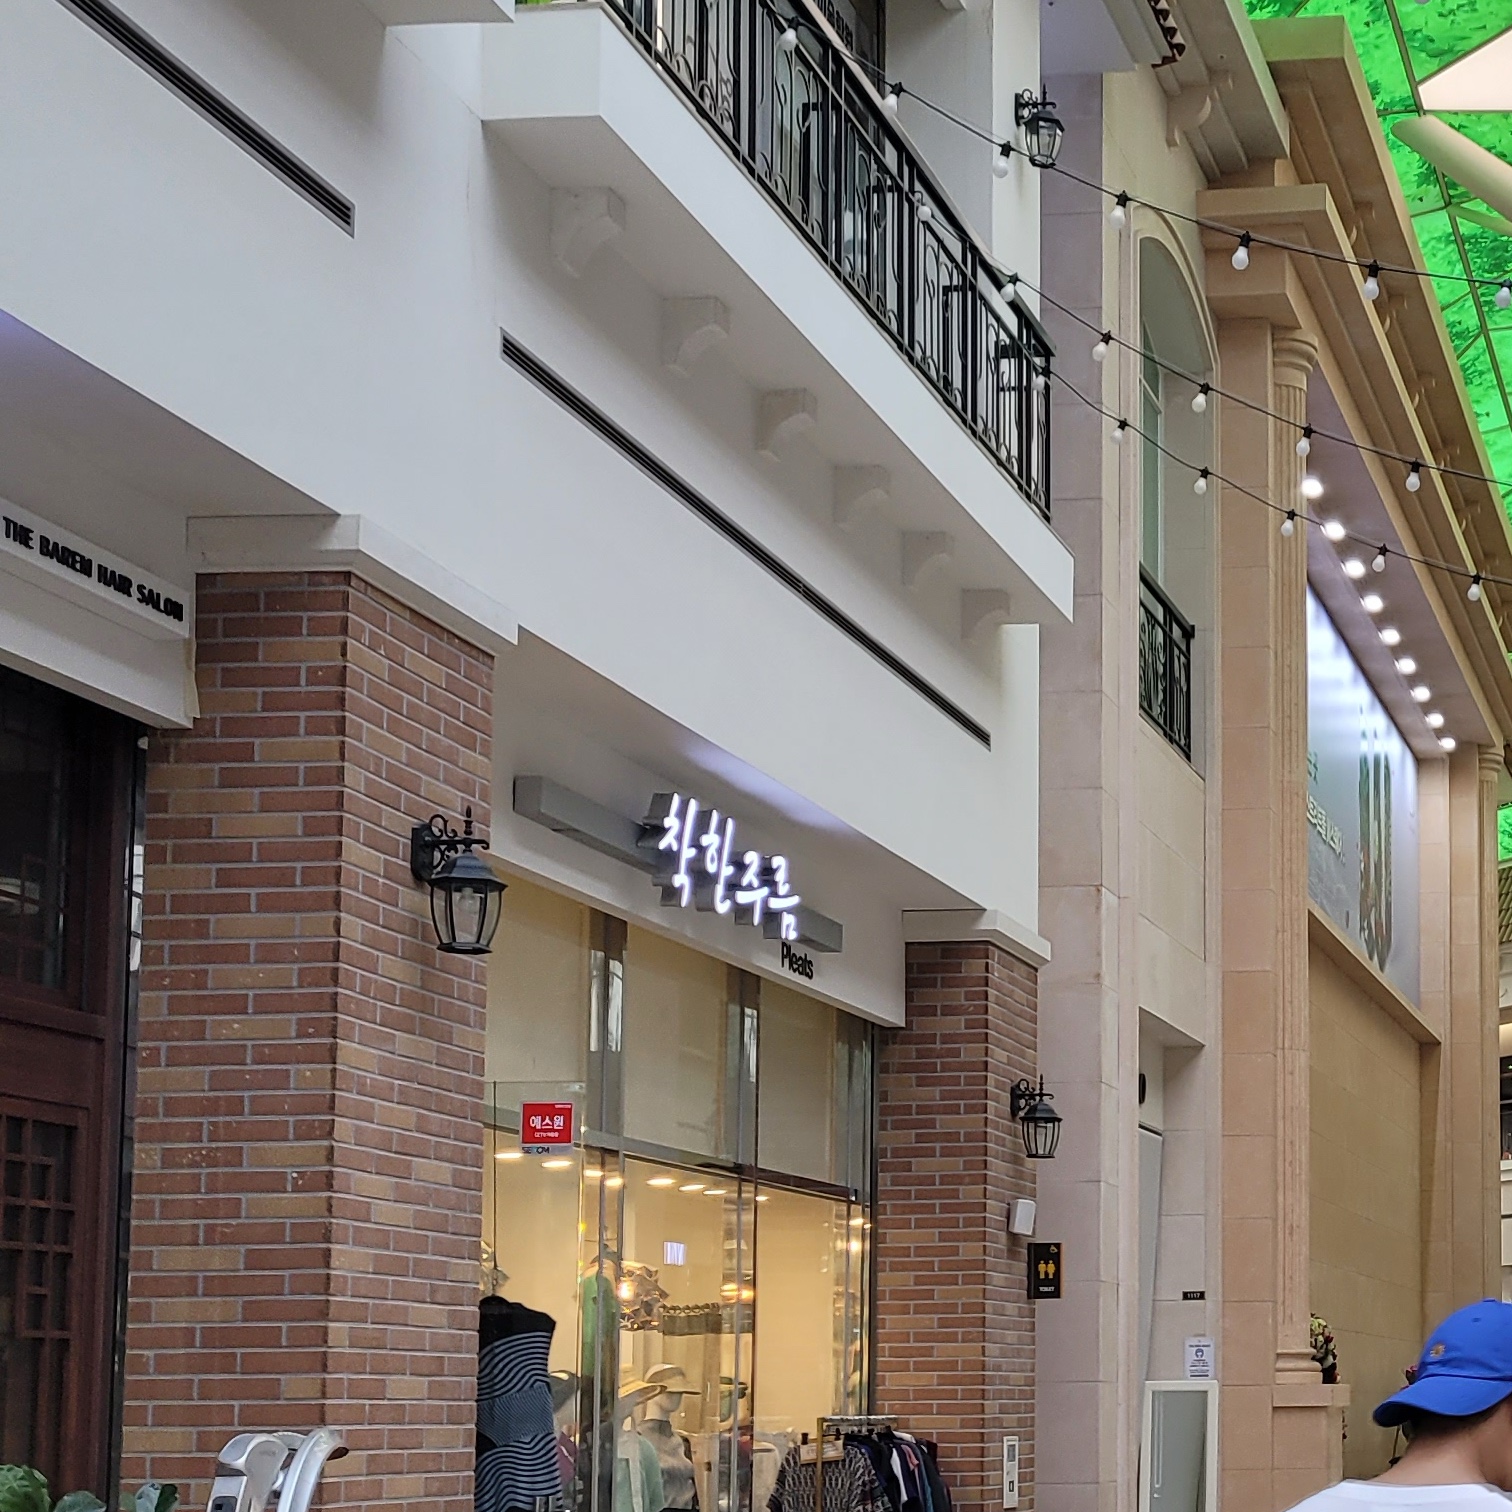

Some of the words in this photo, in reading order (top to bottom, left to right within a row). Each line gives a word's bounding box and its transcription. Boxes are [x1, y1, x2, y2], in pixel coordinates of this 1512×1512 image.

[3, 516, 34, 550] THE
[97, 563, 133, 598] HAIR
[136, 583, 184, 622] SALON
[657, 792, 801, 941] 착한주름
[781, 941, 813, 980] Pleats
[529, 1115, 564, 1129] 에스원
